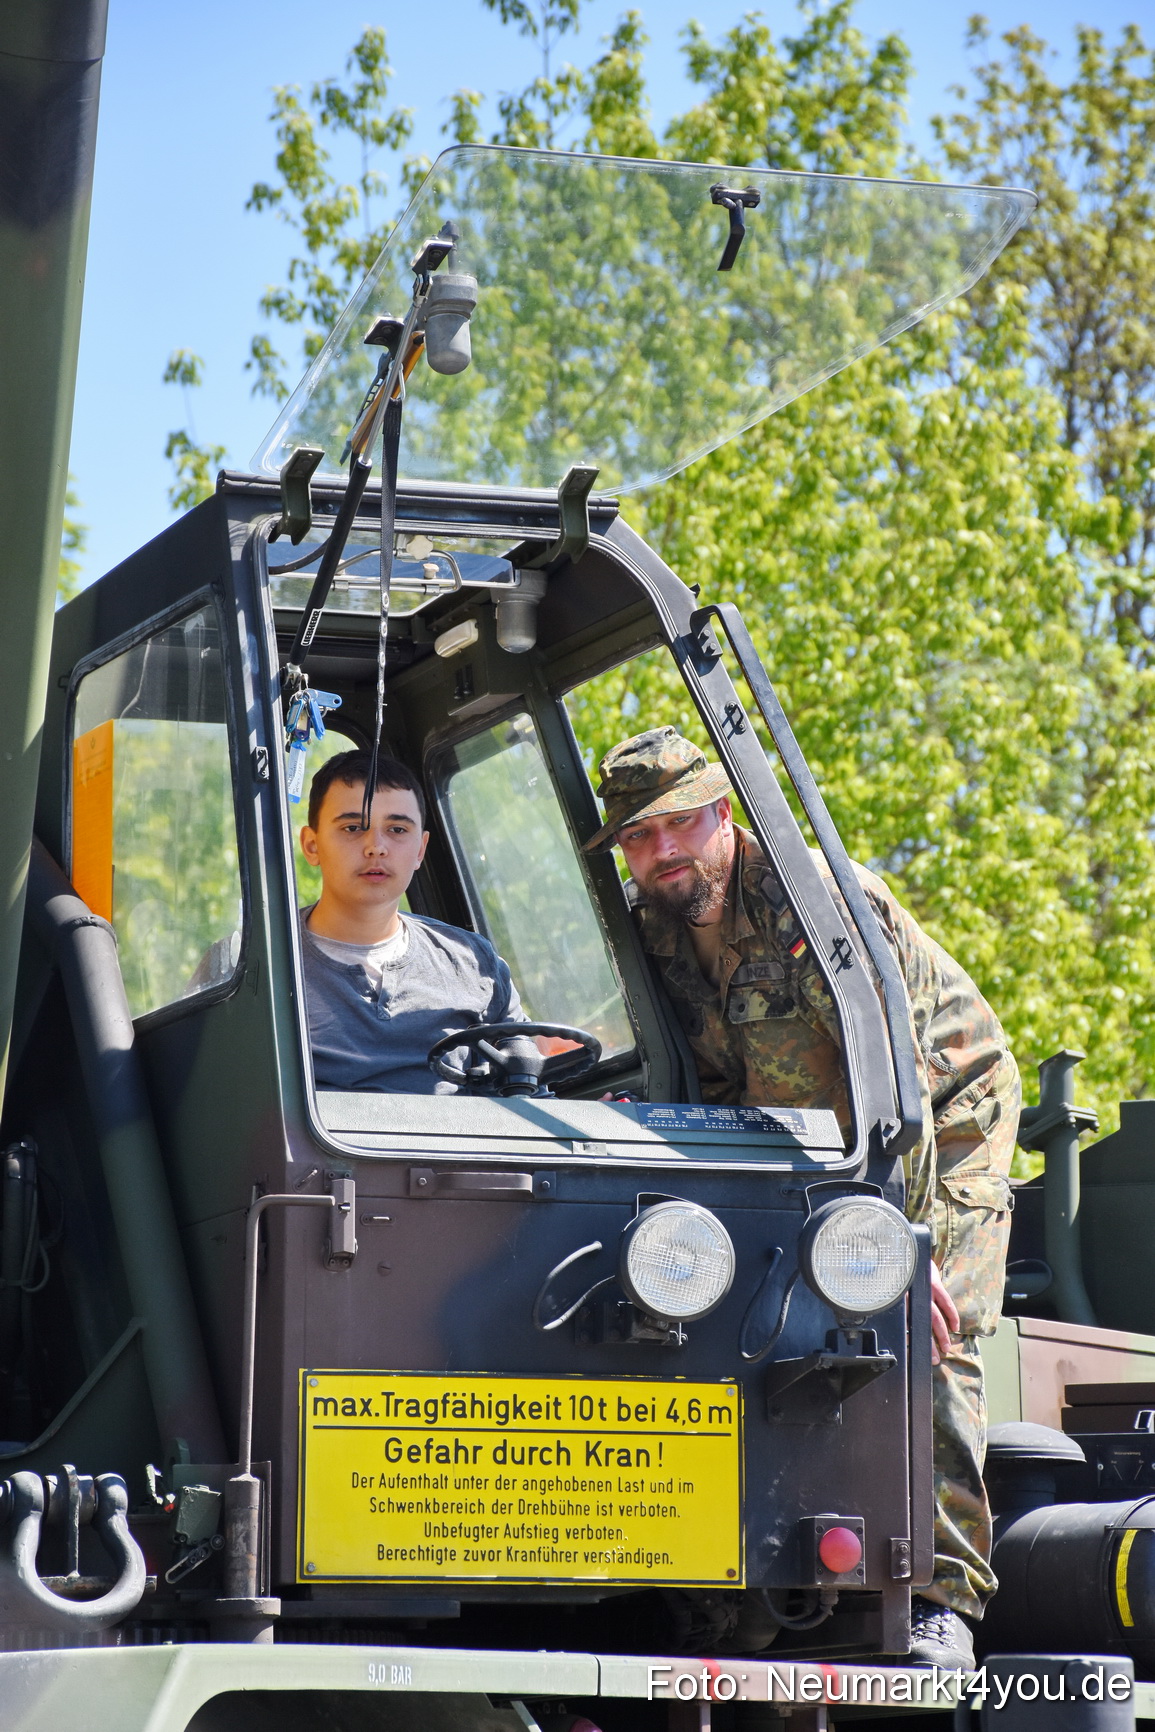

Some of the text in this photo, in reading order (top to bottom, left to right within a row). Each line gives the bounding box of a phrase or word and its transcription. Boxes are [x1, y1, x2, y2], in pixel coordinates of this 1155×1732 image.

[303, 610, 321, 645] LIEBHERR
[617, 1395, 656, 1423] bei
[665, 1397, 702, 1426] 4,6
[708, 1405, 732, 1424] m
[384, 1437, 484, 1465] Gefahr
[492, 1438, 571, 1466] durch
[351, 1471, 694, 1496] Der Aufenthalt unter der angehobenen Last und im
[369, 1496, 682, 1518] Schwenkbereich der Drehbühne ist verboten.
[424, 1521, 500, 1543] Unbefugter
[503, 1522, 559, 1544] Aufstieg
[377, 1543, 675, 1569] Berechtigte zuvor Kranführer verständigen.
[369, 1663, 412, 1687] 9,0 BAR
